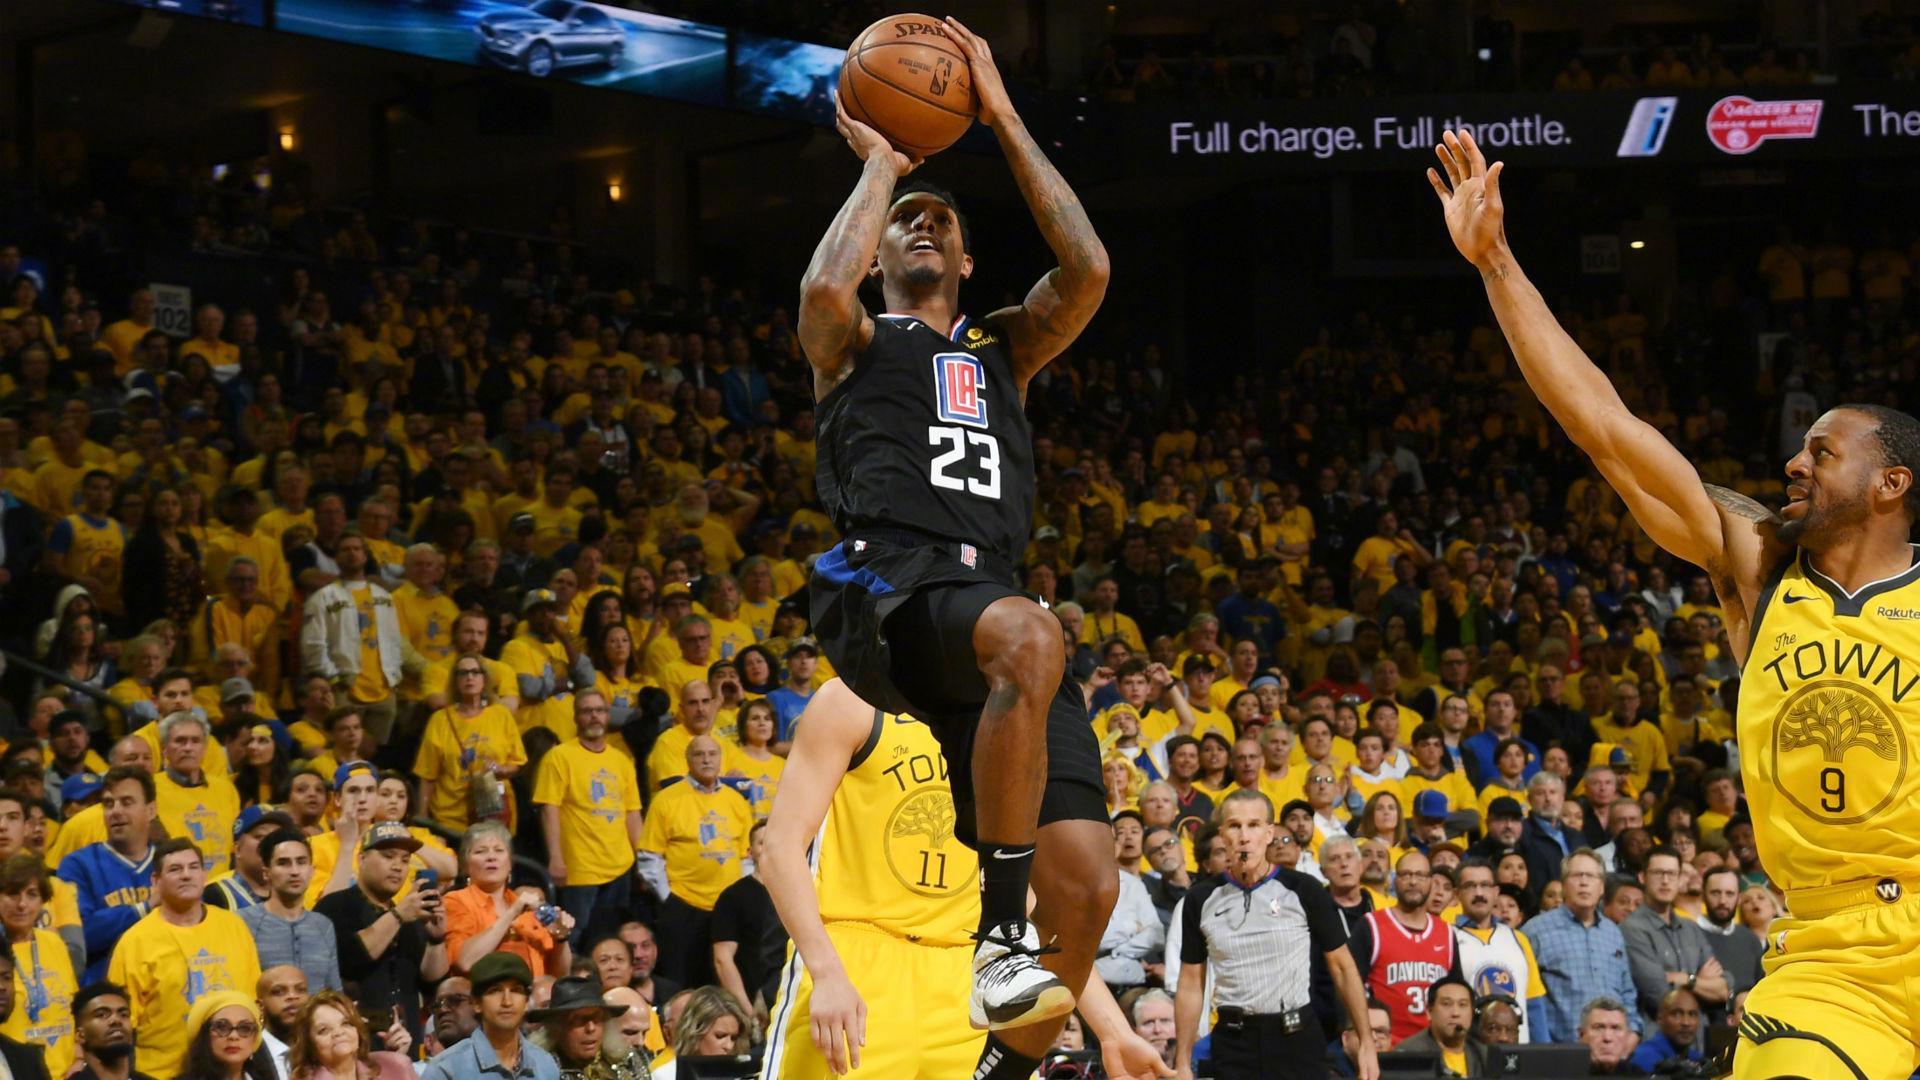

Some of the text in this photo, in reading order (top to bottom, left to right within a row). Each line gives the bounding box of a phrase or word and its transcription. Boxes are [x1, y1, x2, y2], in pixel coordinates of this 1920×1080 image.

[1733, 103, 1791, 115] ACCESS
[1853, 104, 1920, 136] The
[1169, 120, 1231, 155] Full
[1238, 120, 1364, 159] charge.
[1373, 116, 1434, 151] Full
[155, 307, 189, 332] 102
[928, 425, 1001, 499] 23
[1774, 632, 1797, 651] The
[1763, 639, 1920, 703] TOWN
[892, 745, 909, 759] The
[1820, 767, 1845, 812] 9
[916, 850, 948, 889] 11
[1878, 882, 1899, 898] W
[1493, 972, 1509, 984] 30
